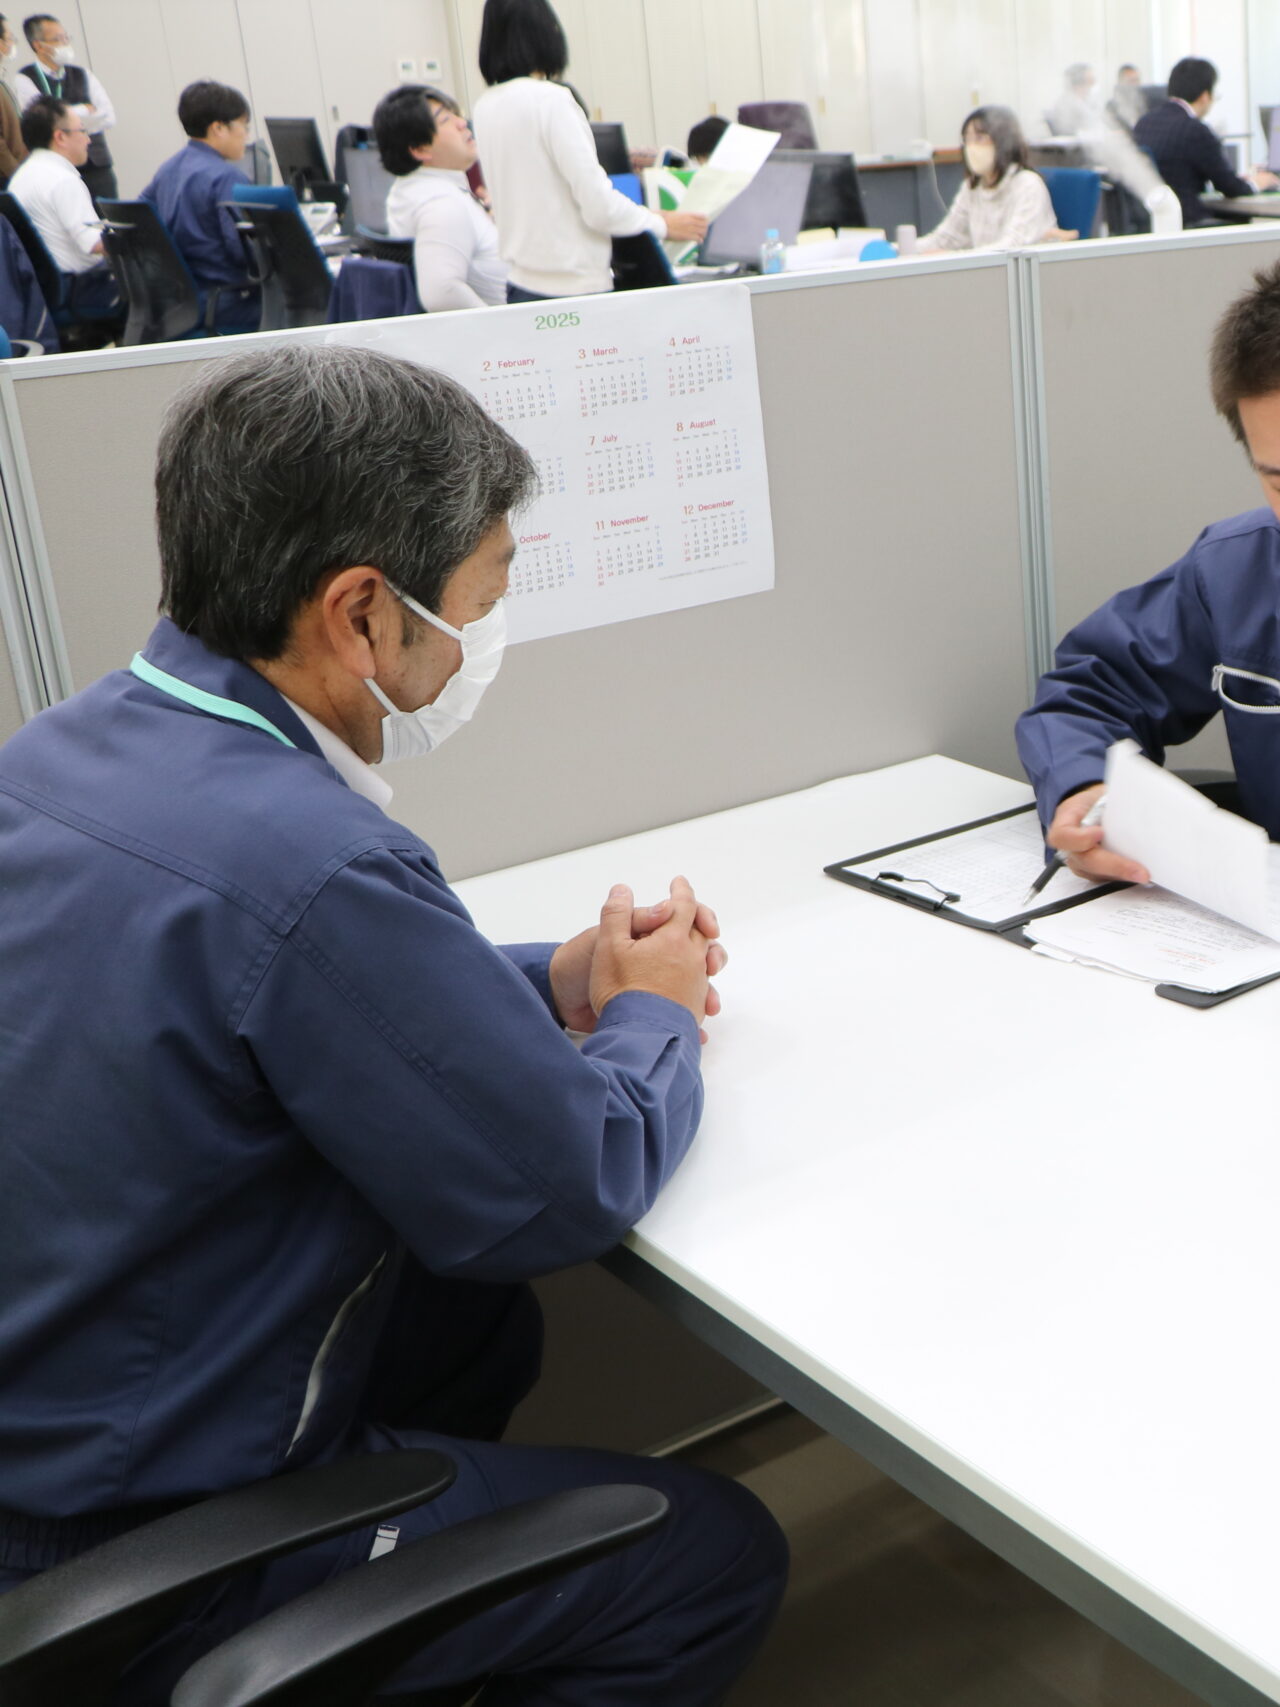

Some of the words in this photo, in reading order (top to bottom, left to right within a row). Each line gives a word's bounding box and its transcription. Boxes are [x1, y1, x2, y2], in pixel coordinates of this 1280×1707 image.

[534, 311, 581, 330] 2025
[668, 337, 676, 347] 4
[682, 335, 701, 345] April
[578, 348, 586, 360] 3
[592, 346, 619, 357] March
[482, 360, 492, 372] 2
[497, 357, 536, 369] February
[676, 421, 684, 432] 8
[689, 418, 716, 429] August
[588, 435, 596, 446] 7
[602, 434, 618, 444] July
[683, 504, 694, 515] 12
[698, 499, 735, 512] December
[595, 519, 605, 531] 11
[610, 514, 649, 528] November
[519, 531, 551, 544] October
